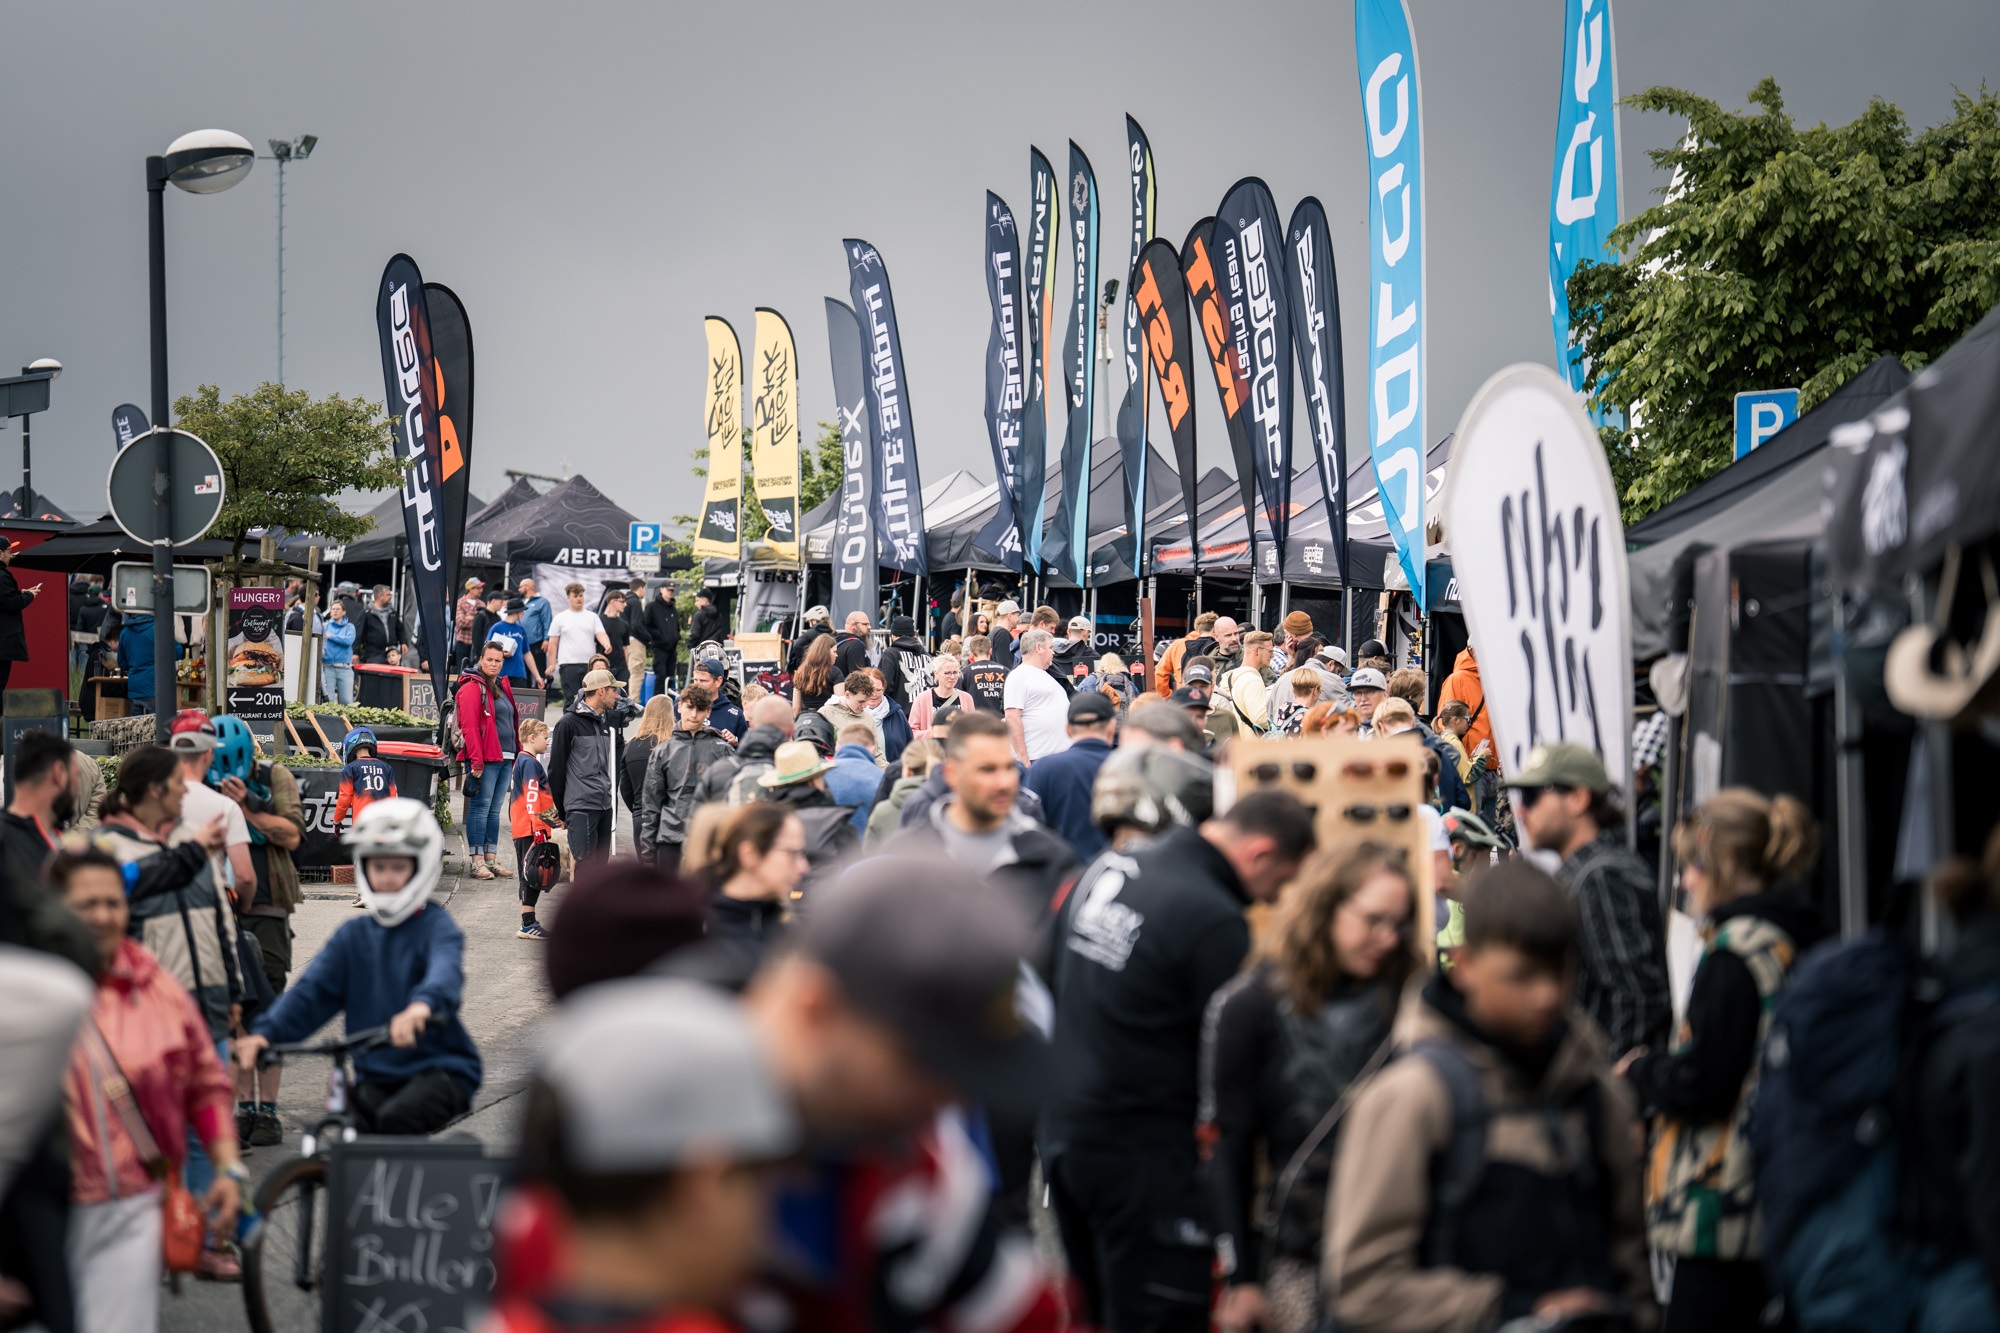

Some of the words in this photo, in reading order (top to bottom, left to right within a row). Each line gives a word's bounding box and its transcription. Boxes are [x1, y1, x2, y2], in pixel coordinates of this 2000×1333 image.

[1750, 403, 1784, 452] P
[636, 526, 654, 550] P
[233, 592, 281, 603] HUNGER?
[255, 692, 282, 706] 20m
[983, 690, 1000, 698] BAR
[228, 711, 262, 719] ESTAURANT
[268, 711, 283, 719] CAFÉ
[361, 765, 384, 776] Tijn
[362, 776, 384, 791] 10
[526, 779, 539, 815] POC
[346, 1158, 459, 1231] Alle
